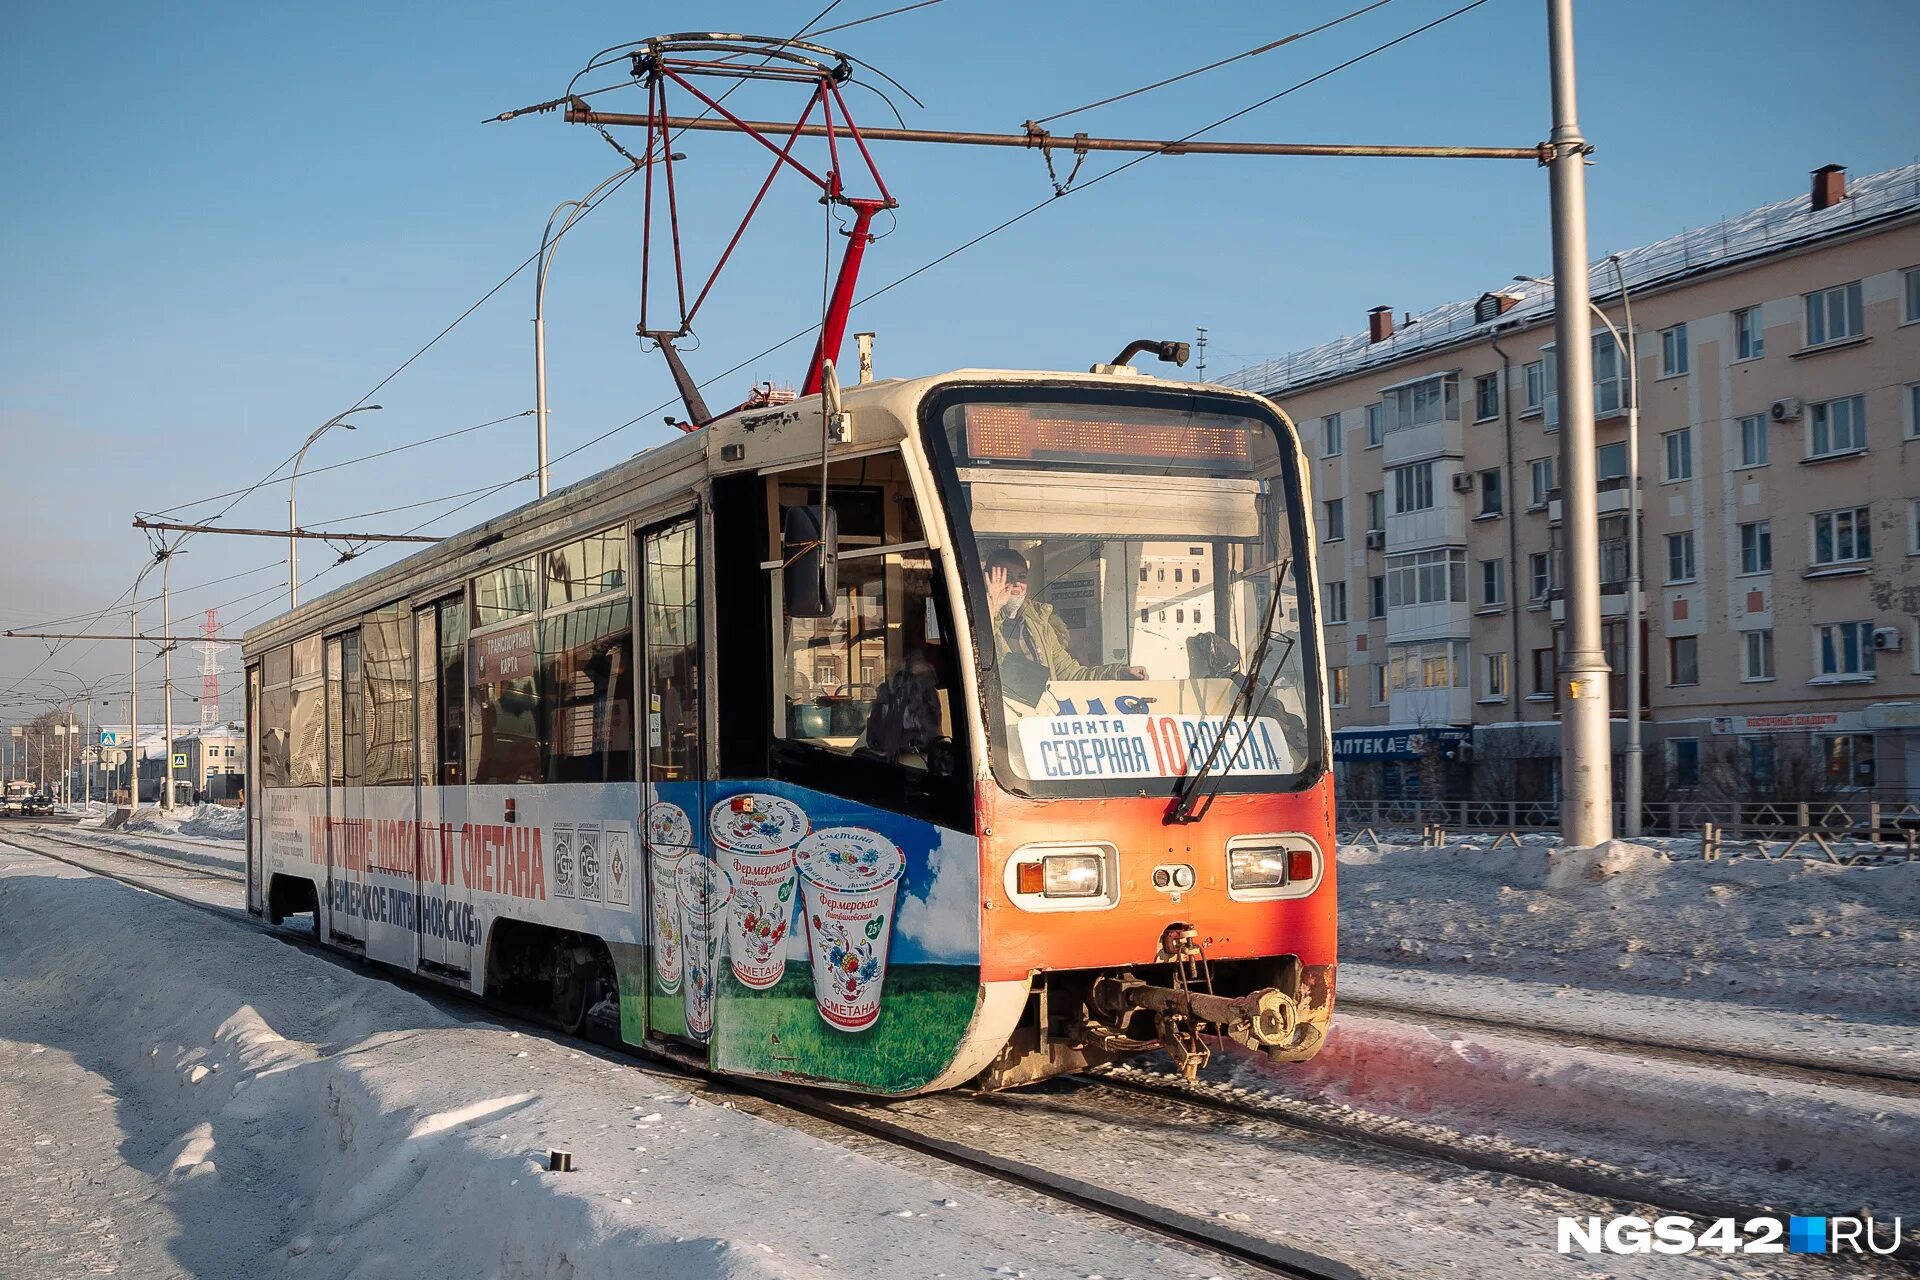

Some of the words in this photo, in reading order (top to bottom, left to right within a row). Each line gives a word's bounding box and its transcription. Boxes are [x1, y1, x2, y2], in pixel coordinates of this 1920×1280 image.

[972, 408, 1020, 455] 10
[487, 631, 531, 655] ТРАНСПОРТНАЯ
[500, 657, 519, 675] КАРТА
[1051, 719, 1125, 736] ШАХТА
[1146, 716, 1188, 777] 10
[1182, 720, 1281, 772] ВОКЗАЛ
[1333, 737, 1396, 755] АПТЕКА
[1040, 736, 1150, 777] СЕВЕРНАЯ
[818, 832, 875, 844] Сметана
[377, 818, 437, 884] МОЛОКО
[439, 822, 455, 886] И
[461, 822, 546, 901] СМЕТАНА
[733, 858, 792, 878] Фермерская
[819, 892, 879, 914] Фермерская
[825, 910, 873, 921] Литвиновская
[737, 960, 783, 977] СМЕТАНА
[824, 997, 875, 1017] СМЕТАНА
